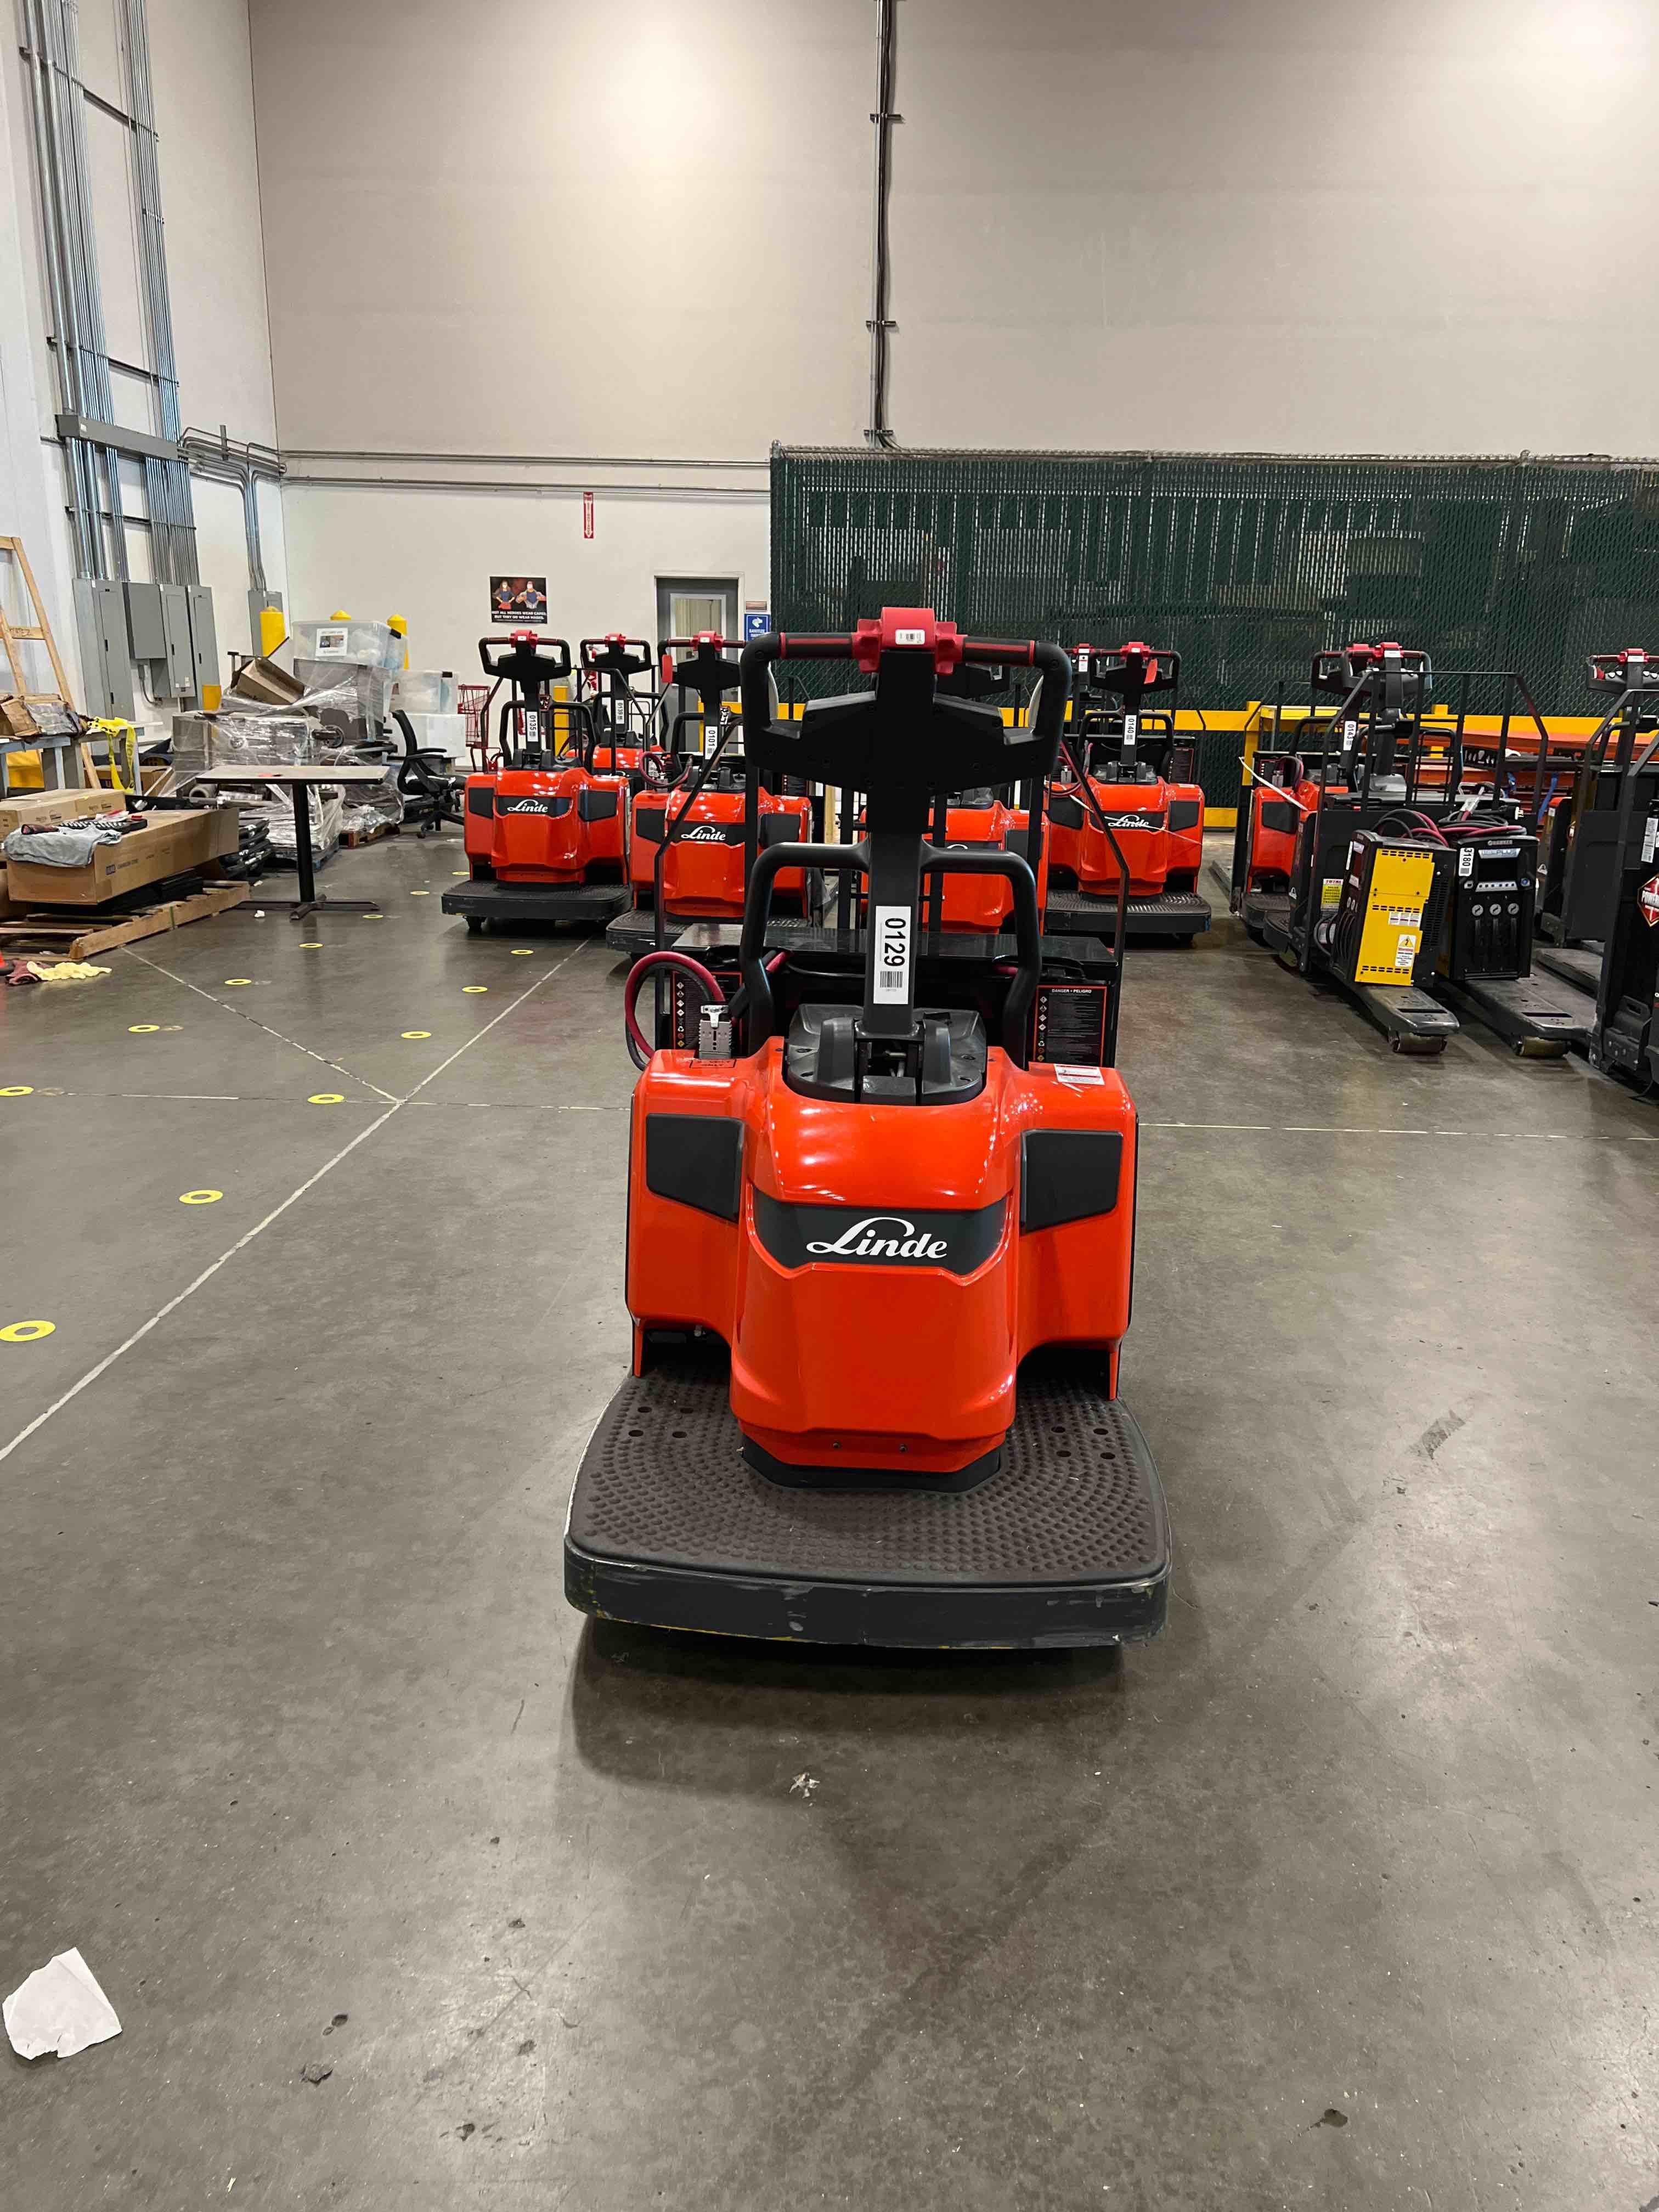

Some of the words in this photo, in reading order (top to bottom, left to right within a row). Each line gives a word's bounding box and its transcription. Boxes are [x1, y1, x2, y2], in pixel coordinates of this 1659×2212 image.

[507, 799, 548, 812] Linde
[1108, 815, 1149, 827] Linde
[681, 826, 726, 840] Linde
[1462, 848, 1472, 866] 3180
[884, 918, 906, 967] 0129
[806, 1217, 947, 1259] Linde
